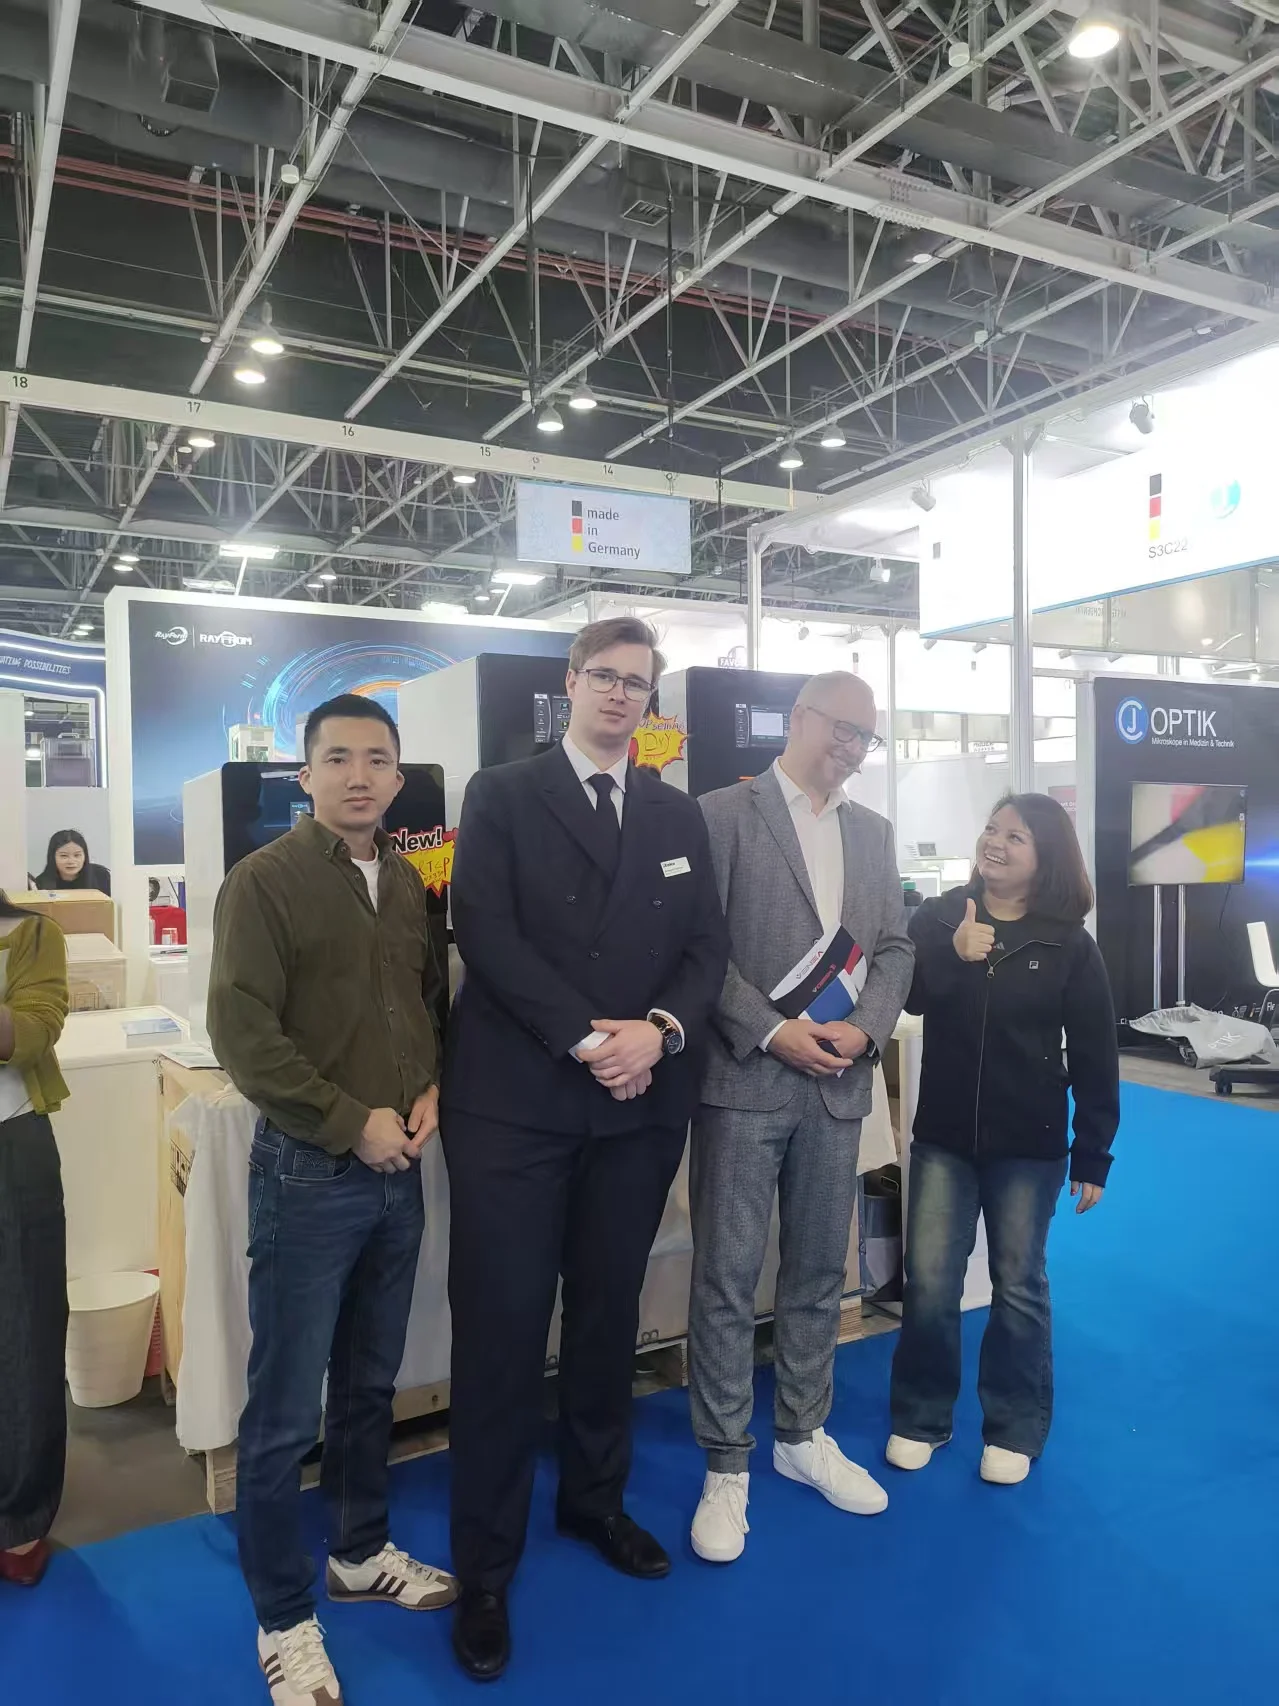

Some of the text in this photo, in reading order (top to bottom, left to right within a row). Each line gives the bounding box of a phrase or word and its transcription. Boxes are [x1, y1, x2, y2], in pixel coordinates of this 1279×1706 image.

[13, 376, 28, 388] 18
[187, 401, 201, 413] 17
[342, 425, 355, 437] 16
[480, 446, 491, 457] 15
[603, 464, 614, 475] 14
[587, 507, 620, 521] made
[587, 523, 598, 536] in
[588, 541, 641, 560] Germany
[23, 659, 72, 675] POSSIBILITIES
[1150, 707, 1217, 737] OPTIK
[1151, 737, 1182, 747] Mikroskope
[1183, 738, 1189, 746] in
[1189, 739, 1209, 747] Medizin
[1215, 740, 1235, 748] Technik
[392, 826, 443, 853] New!
